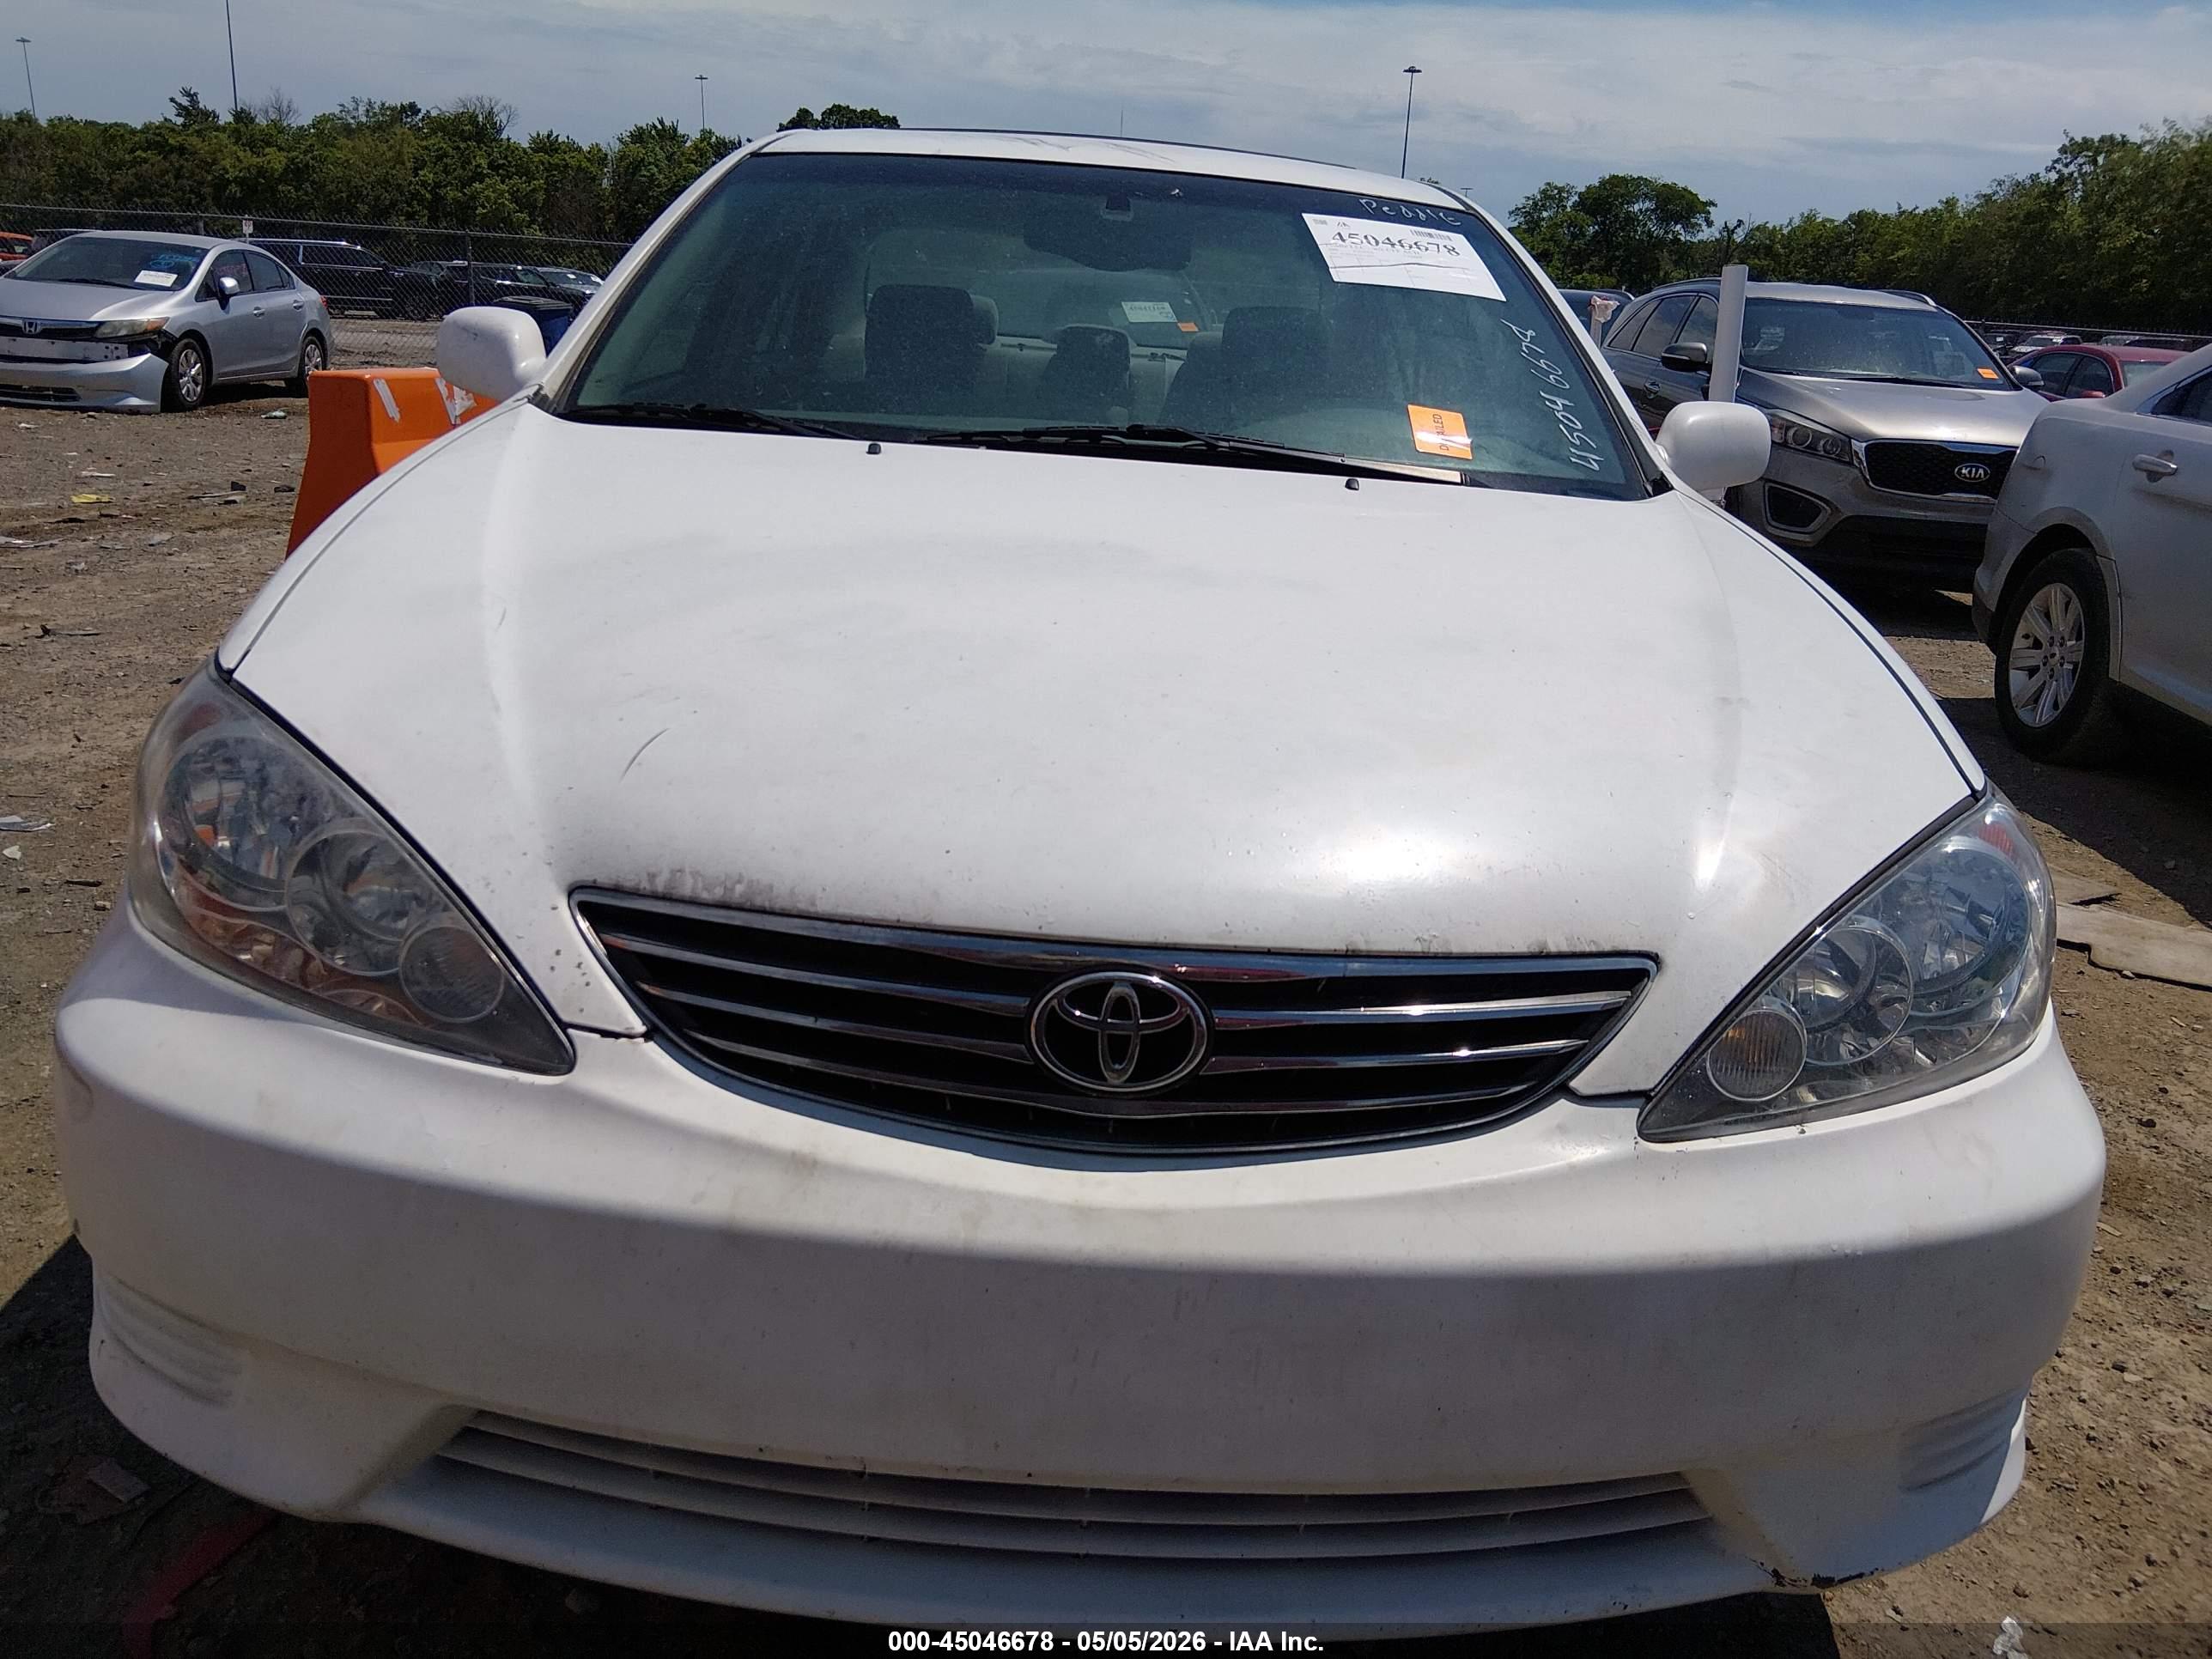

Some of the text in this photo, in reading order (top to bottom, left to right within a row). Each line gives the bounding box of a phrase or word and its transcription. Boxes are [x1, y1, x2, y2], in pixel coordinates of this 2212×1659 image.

[1332, 231, 1461, 257] 45046678
[1500, 319, 1604, 471] 45046678
[1961, 466, 1984, 478] KIA
